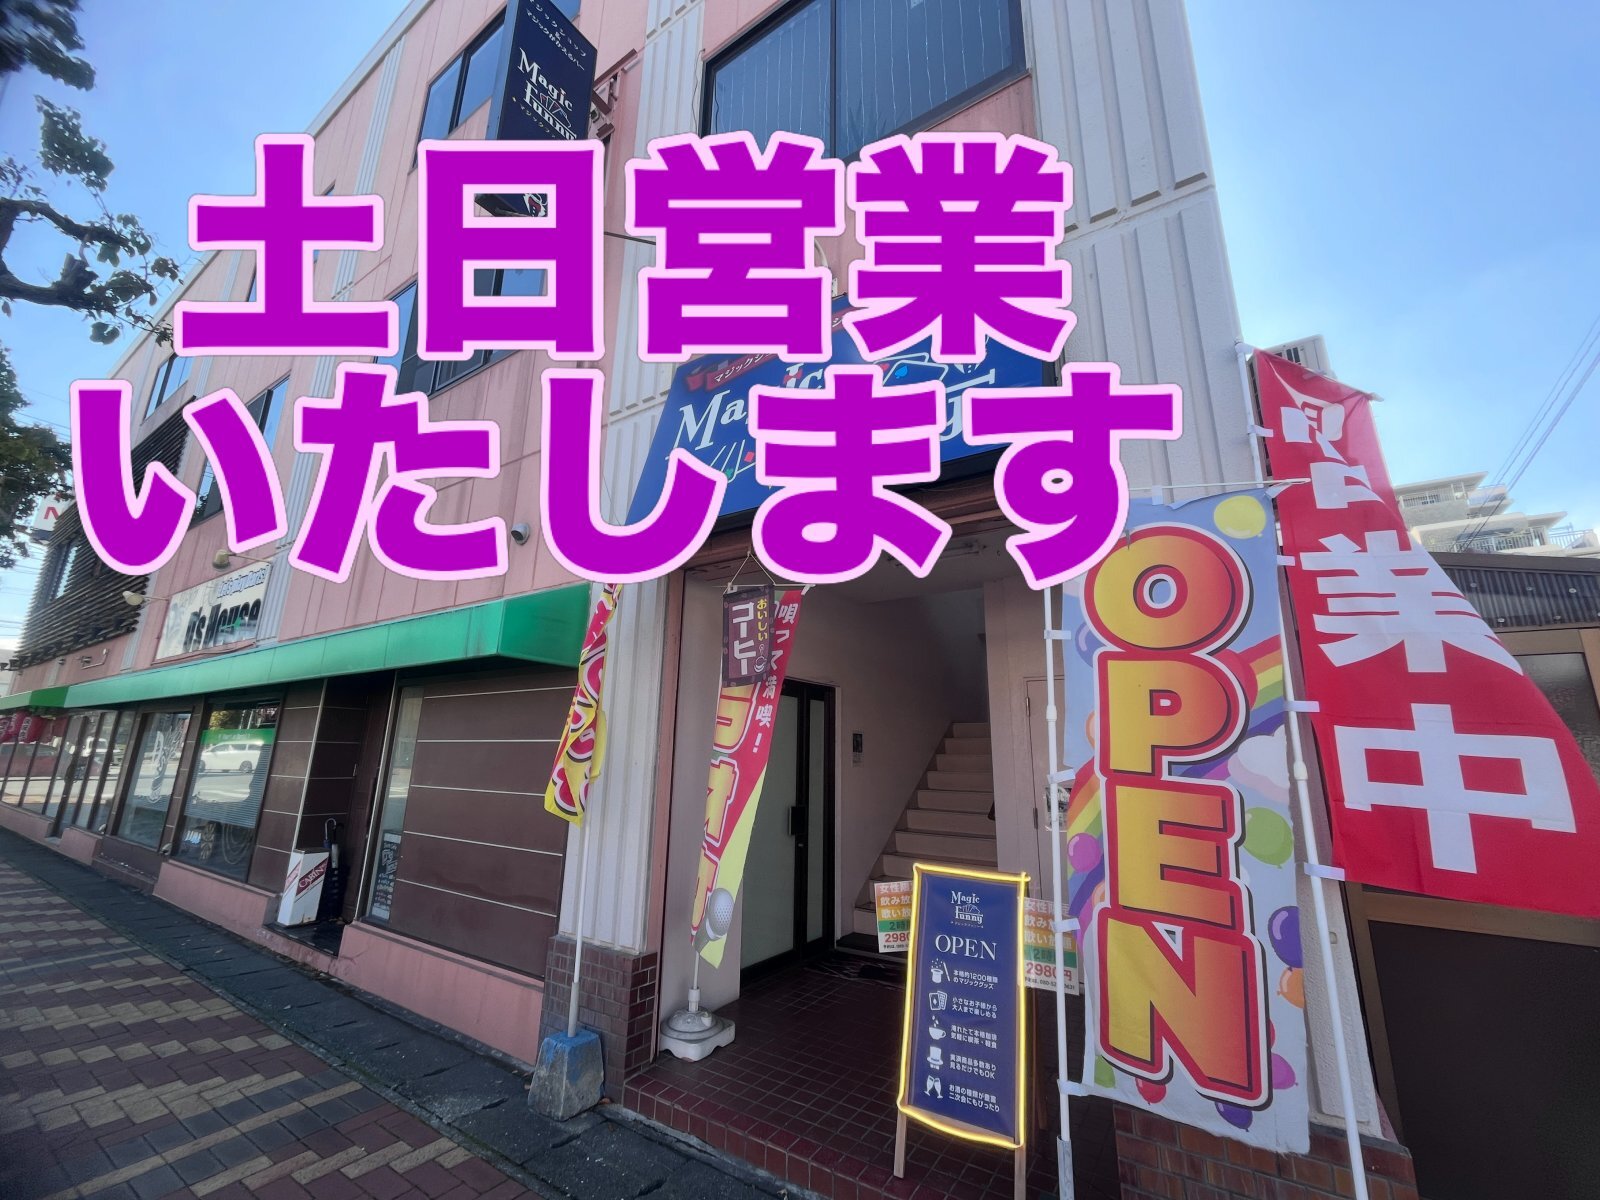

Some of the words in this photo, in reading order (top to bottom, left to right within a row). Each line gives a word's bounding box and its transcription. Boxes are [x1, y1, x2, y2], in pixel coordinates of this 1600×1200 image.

[517, 47, 573, 112] Magic
[757, 598, 768, 641] おいしい
[732, 602, 757, 675] コーヒー
[1084, 527, 1270, 1103] OPEN
[880, 882, 913, 893] 女性限
[951, 890, 980, 905] Magic
[880, 896, 913, 906] 飲み放
[881, 908, 911, 918] 歌い放
[955, 905, 984, 925] Funny
[935, 934, 997, 961] OPEN
